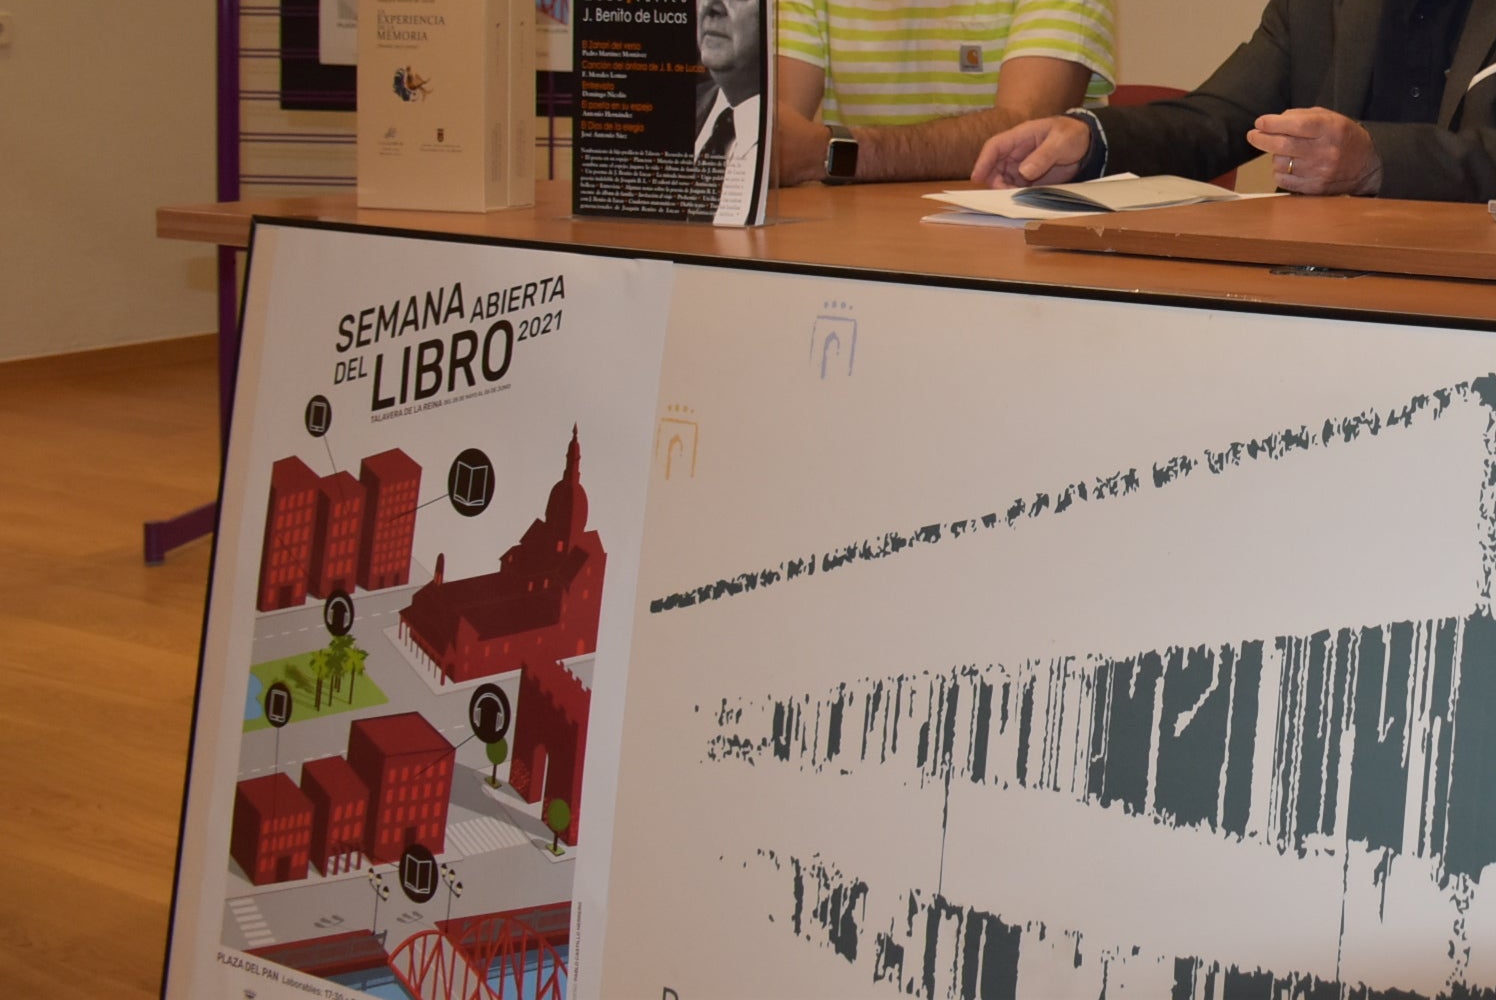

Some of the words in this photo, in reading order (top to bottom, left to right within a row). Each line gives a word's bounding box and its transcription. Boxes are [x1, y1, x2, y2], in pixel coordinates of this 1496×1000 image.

[377, 15, 445, 25] EXPERIENCIA
[582, 7, 592, 22] J.
[595, 7, 632, 22] Benito
[634, 9, 651, 23] de
[654, 9, 688, 24] Lucas
[377, 31, 428, 41] MEMORIA
[335, 282, 465, 353] SEMANA
[469, 275, 566, 324] ABIERTA
[333, 356, 368, 386] DEL
[371, 319, 514, 412] LIBRO
[517, 310, 563, 342] 2021
[371, 411, 403, 423] TALAVERA
[404, 406, 413, 416] DE
[414, 404, 422, 413] LA
[423, 400, 442, 411] REINA
[216, 952, 244, 969] PLAZA
[244, 960, 261, 976] DEL
[261, 967, 279, 981] PAN
[282, 976, 322, 997] Laborables:
